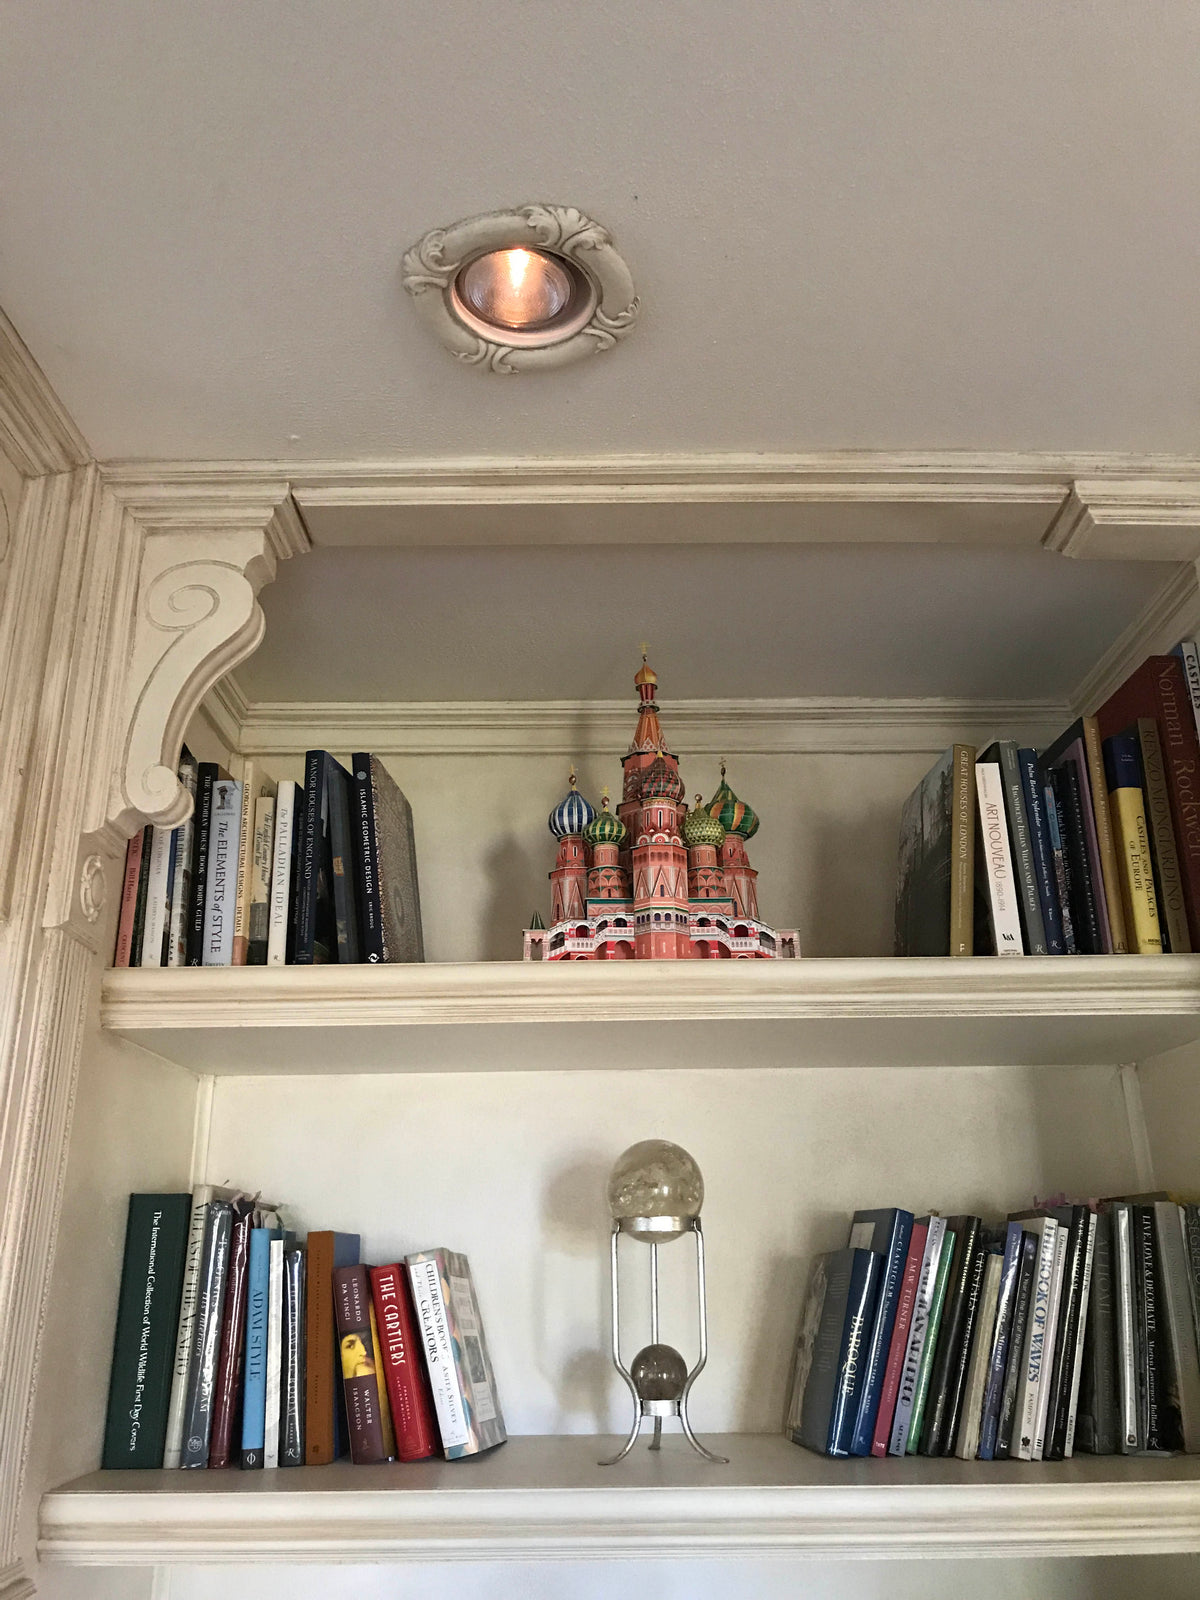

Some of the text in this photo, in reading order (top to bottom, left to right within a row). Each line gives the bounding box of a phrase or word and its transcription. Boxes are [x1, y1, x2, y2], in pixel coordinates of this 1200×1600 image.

[1186, 654, 1200, 710] CASTLES
[309, 758, 318, 788] MANOR
[960, 750, 968, 776] GREAT
[1143, 730, 1163, 781] RENZO
[1156, 662, 1200, 857] Norman Rockwell
[204, 776, 212, 788] THE
[960, 780, 968, 810] HOUSES
[1027, 763, 1042, 826] Palm Beach Splendor
[202, 792, 210, 826] VICTORIAN
[308, 790, 316, 822] HOUSES
[960, 812, 968, 824] OF
[985, 802, 998, 821] ART
[1011, 784, 1022, 824] MAGNIFICENT
[240, 818, 248, 868] ARCHITECTURAL
[306, 824, 314, 834] OF
[360, 788, 372, 894] ISLAMIC GEOMETRIC DESIGN
[1018, 826, 1027, 848] ITALIAN
[198, 856, 206, 874] BOOK
[261, 844, 270, 866] Country
[274, 808, 288, 928] The PALLADIAN IDEAL
[304, 838, 314, 879] ENGLAND
[987, 823, 1006, 878] NOUVEAU
[1021, 849, 1031, 870] VILLAS
[1128, 841, 1142, 892] OF EUROPE
[1136, 816, 1156, 918] CASTLES AND PALACES
[1150, 787, 1182, 912] MONGIARDINO
[126, 868, 137, 902] Bill Harris
[196, 884, 204, 907] ROBIN
[210, 822, 228, 952] The ELEMENTS of STYLE
[994, 881, 1006, 912] 1890-1914
[1026, 885, 1036, 912] PALACES
[1072, 1240, 1082, 1290] CLASSICISM
[1097, 1236, 1109, 1255] AT
[1144, 1242, 1154, 1270] LOVE
[176, 1202, 210, 1376] VILLAS OF THE VENETO
[342, 1284, 348, 1294] DA
[888, 1242, 902, 1298] CLASSICISM
[968, 1252, 985, 1311] CRYSTALS
[1022, 1279, 1030, 1292] Year
[1144, 1270, 1152, 1278] &
[252, 1289, 264, 1330] ADAM
[352, 1278, 362, 1322] LEONARDO
[425, 1264, 444, 1324] CHILDREN'S
[898, 1257, 918, 1330] J.M.W. TURNER
[1028, 1224, 1056, 1382] THE BOOK OF WAVES
[1146, 1280, 1156, 1332] DECORATE
[130, 1211, 162, 1452] The International Collection of World Wildlife First Day Covers
[379, 1274, 406, 1366] THE CARTIERS
[420, 1300, 439, 1362] CREATORS
[1018, 1312, 1027, 1324] Life
[250, 1336, 262, 1382] STYLE
[842, 1316, 864, 1396] BAROQUE
[874, 1340, 883, 1366] QUINLAN
[994, 1335, 1006, 1372] Minerals
[1011, 1346, 1020, 1373] Universe
[1148, 1340, 1156, 1366] Martyn
[364, 1389, 372, 1424] WALTER
[403, 1386, 411, 1420] FRANCESCA
[442, 1366, 456, 1424] ANITA SILVEY
[900, 1366, 916, 1407] DECO
[352, 1388, 362, 1430] ISAACSON
[1026, 1393, 1034, 1425] KAMPION
[1150, 1404, 1158, 1432] Bullard
